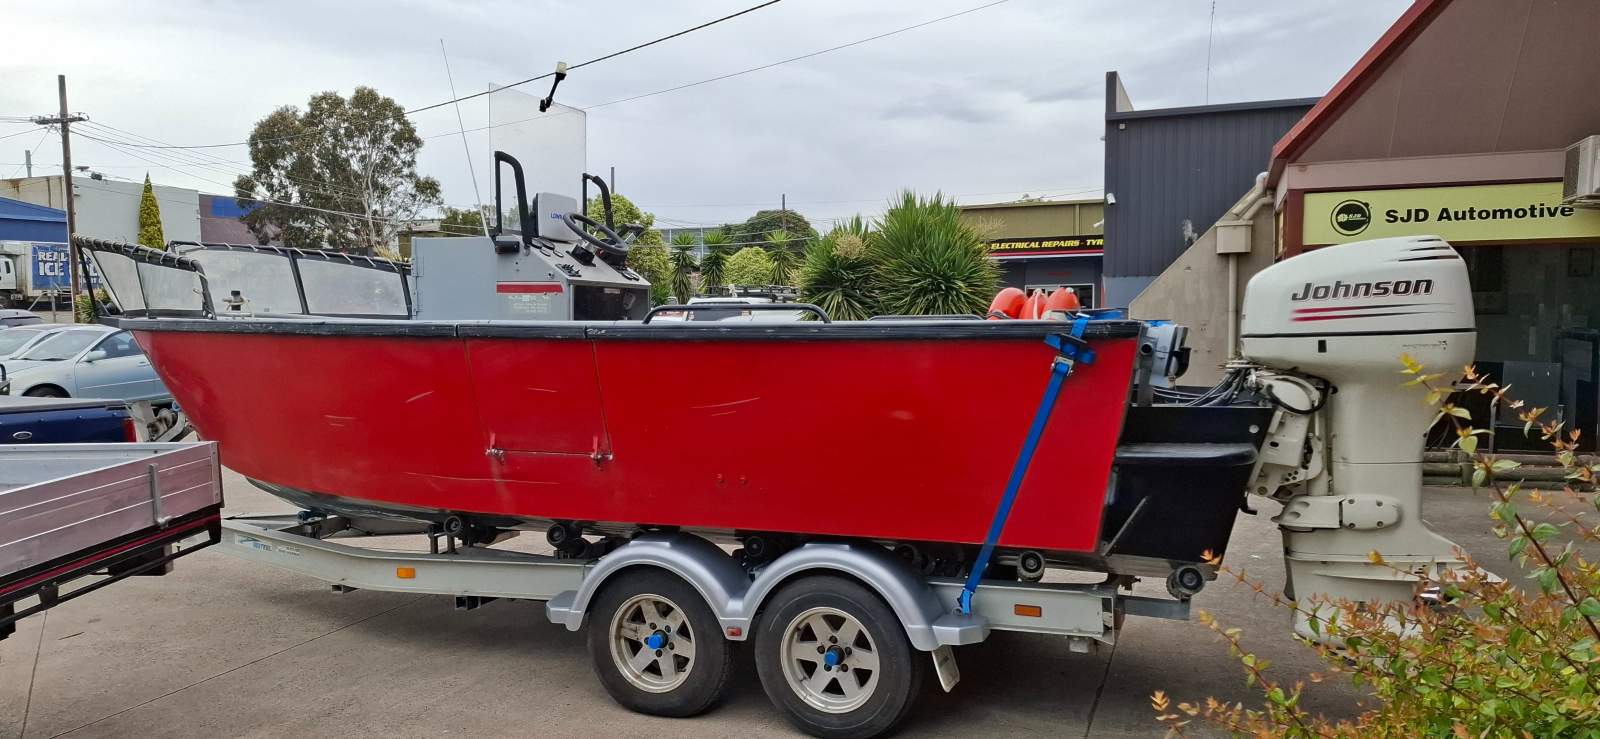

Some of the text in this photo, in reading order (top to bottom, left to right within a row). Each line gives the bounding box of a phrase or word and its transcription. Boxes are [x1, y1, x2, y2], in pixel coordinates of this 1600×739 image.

[1385, 203, 1574, 223] SJD Automotive
[991, 241, 1041, 250] ELECTRICAL
[1041, 239, 1080, 248] REPAIRS
[1086, 238, 1104, 246] TYR
[38, 251, 68, 262] REAL
[39, 262, 65, 276] ICE
[1291, 278, 1435, 302] Johnson
